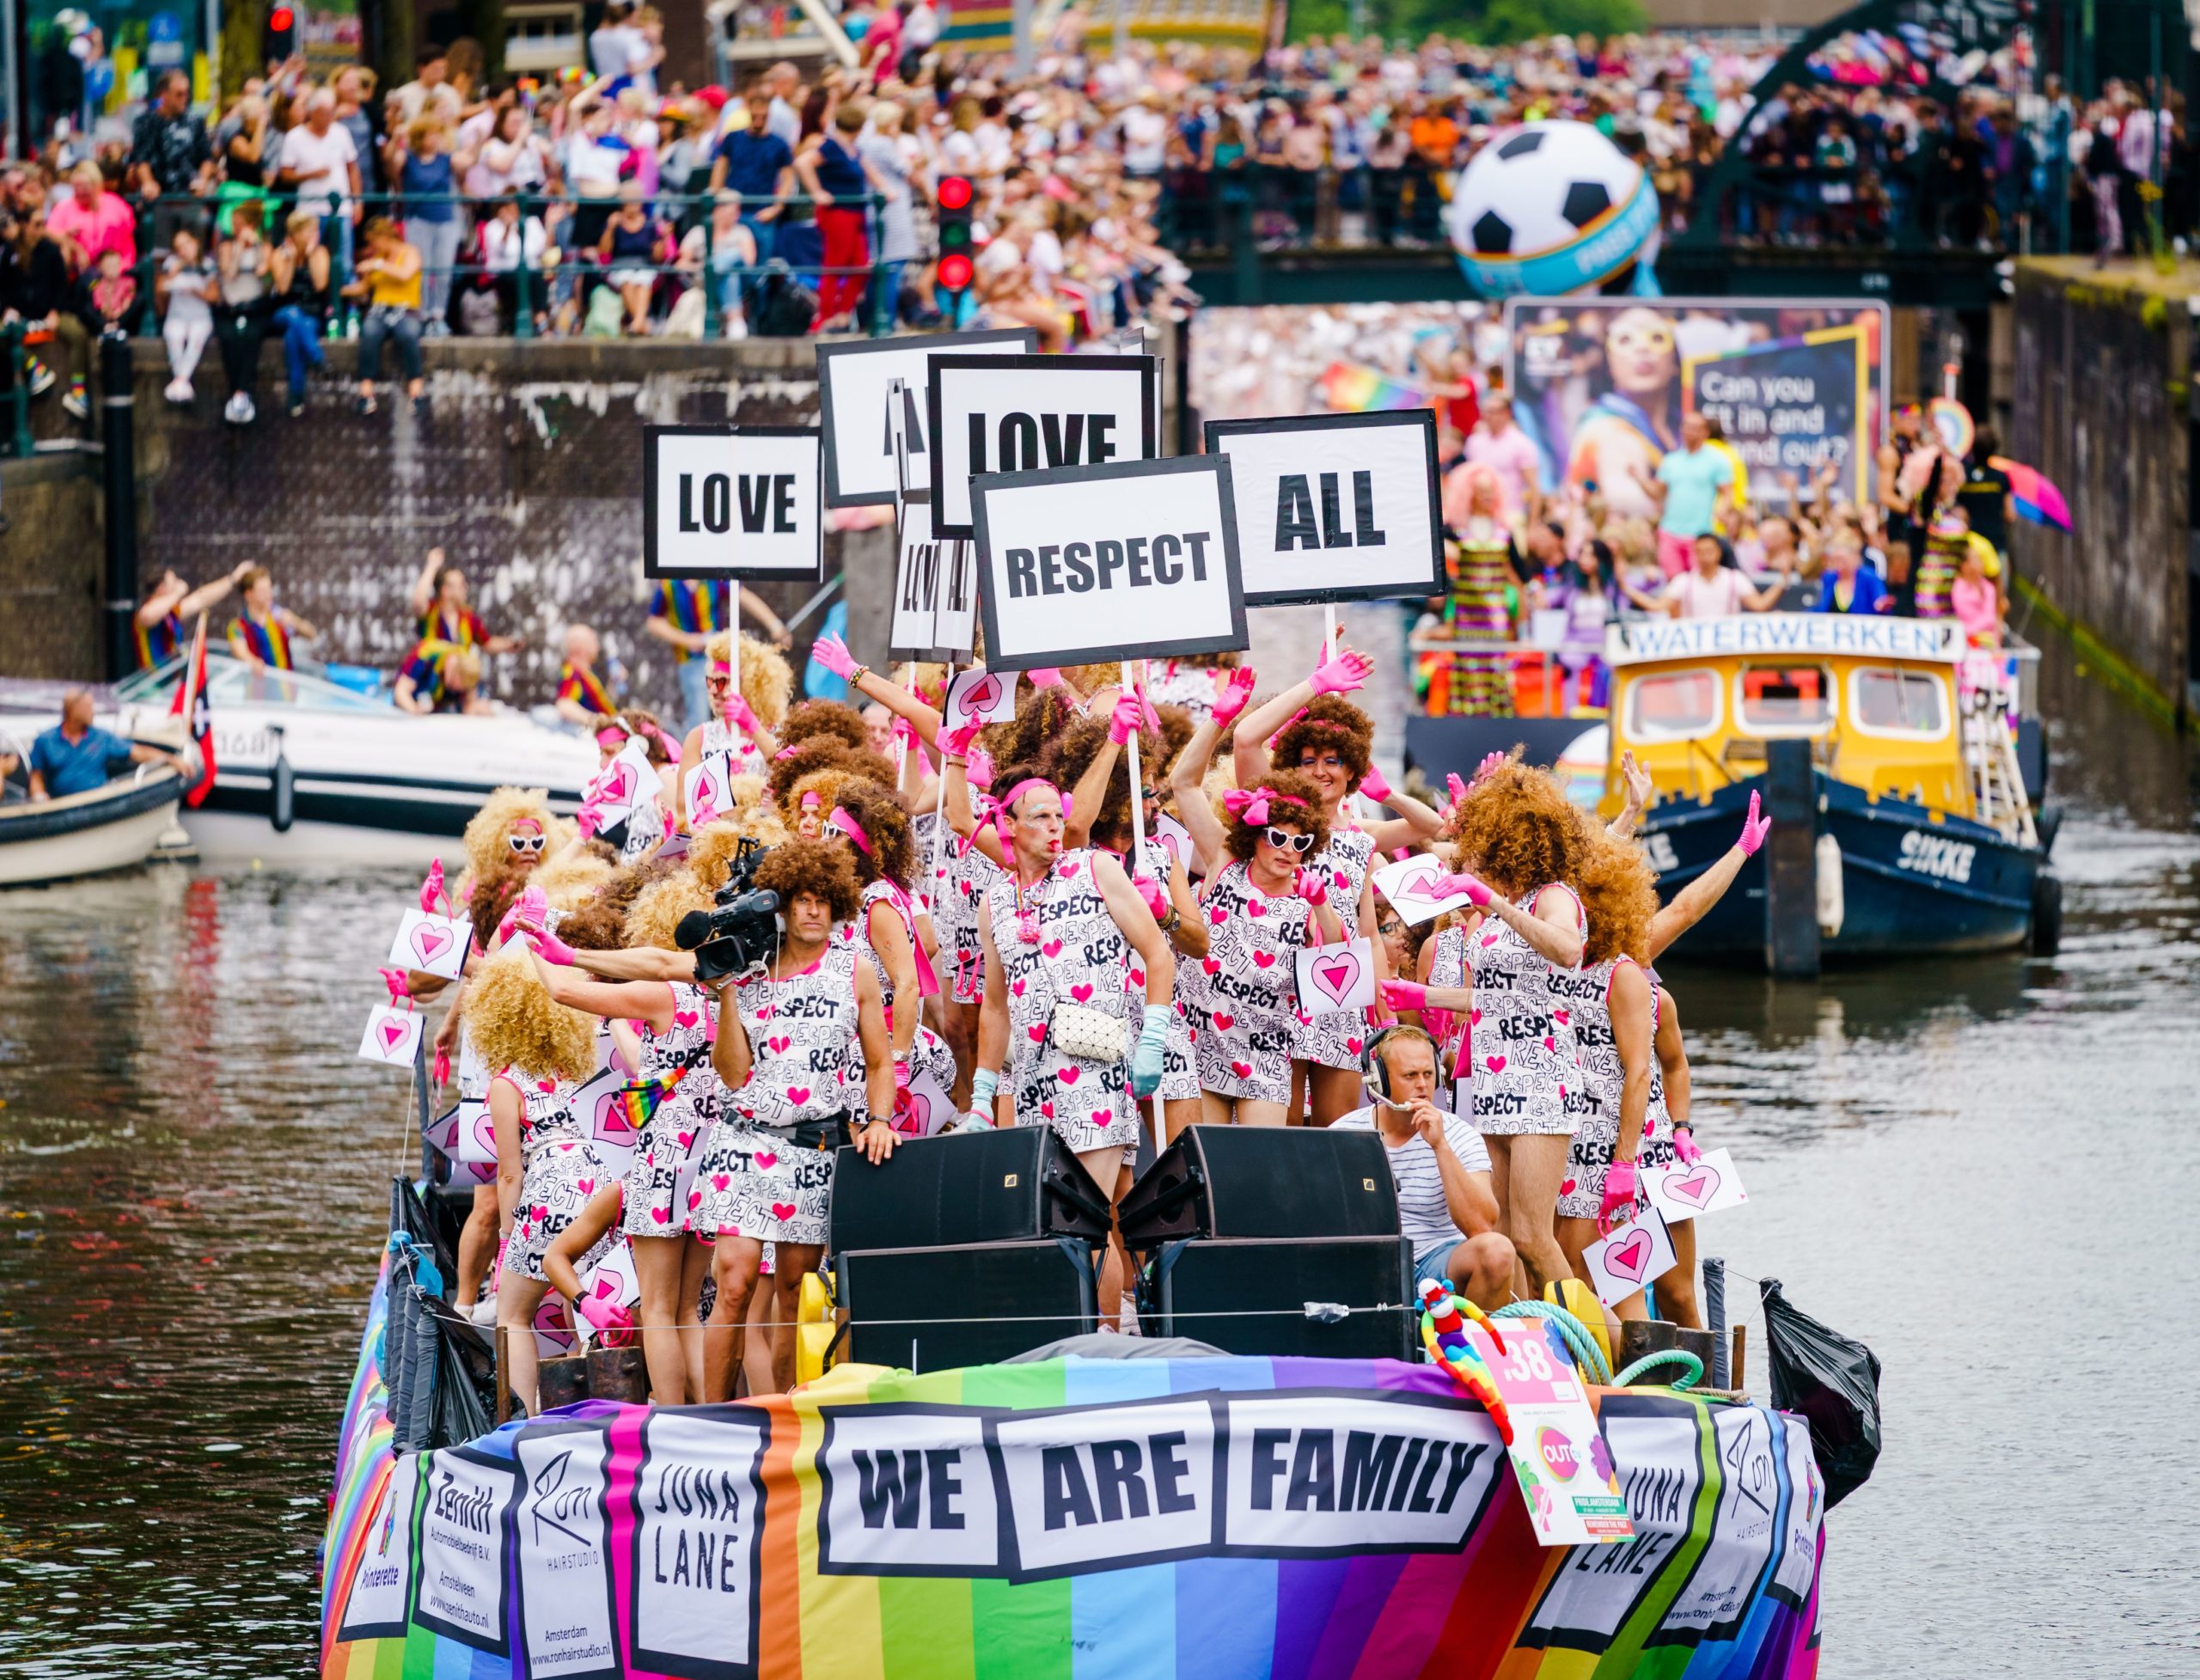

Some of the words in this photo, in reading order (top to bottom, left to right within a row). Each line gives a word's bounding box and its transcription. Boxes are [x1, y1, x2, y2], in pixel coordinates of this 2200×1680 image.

[1701, 371, 1757, 403] Can
[1760, 376, 1815, 407] you
[1738, 403, 1767, 434] in
[1769, 404, 1825, 435] and
[969, 412, 1116, 476] LOVE
[679, 473, 797, 534] LOVE
[1275, 470, 1386, 552] ALL
[902, 543, 941, 613] LOV
[1005, 531, 1210, 598] RESPECT
[1633, 620, 1940, 655] WATERWERKEN
[1897, 830, 1977, 884] SIKKE
[1038, 894, 1105, 925] ESPECT
[1083, 935, 1122, 968] RESP
[1478, 949, 1548, 972] RESPEC
[1211, 971, 1279, 1010] RESPECT
[810, 1048, 844, 1073] RESP
[1293, 1020, 1353, 1067] SPECT
[1493, 1072, 1555, 1095] RESPEC
[1473, 1093, 1526, 1115] ESPECT
[794, 1162, 833, 1190] RESP
[706, 1189, 779, 1234] SPECT
[1559, 1196, 1601, 1219] RESP
[777, 1221, 828, 1243] RESPE
[655, 1463, 739, 1524] JUNA
[852, 1447, 966, 1530] WE
[1041, 1429, 1196, 1531] ARE
[1250, 1427, 1490, 1515] FAMILY
[434, 1470, 493, 1535] Zenith
[547, 1550, 599, 1573] HAIRSTUDIO
[655, 1525, 738, 1592] LANE
[439, 1571, 475, 1598] Amstelveen
[545, 1625, 588, 1643] Amsterdam
[530, 1641, 611, 1666] www.ronhairstudio.nl
